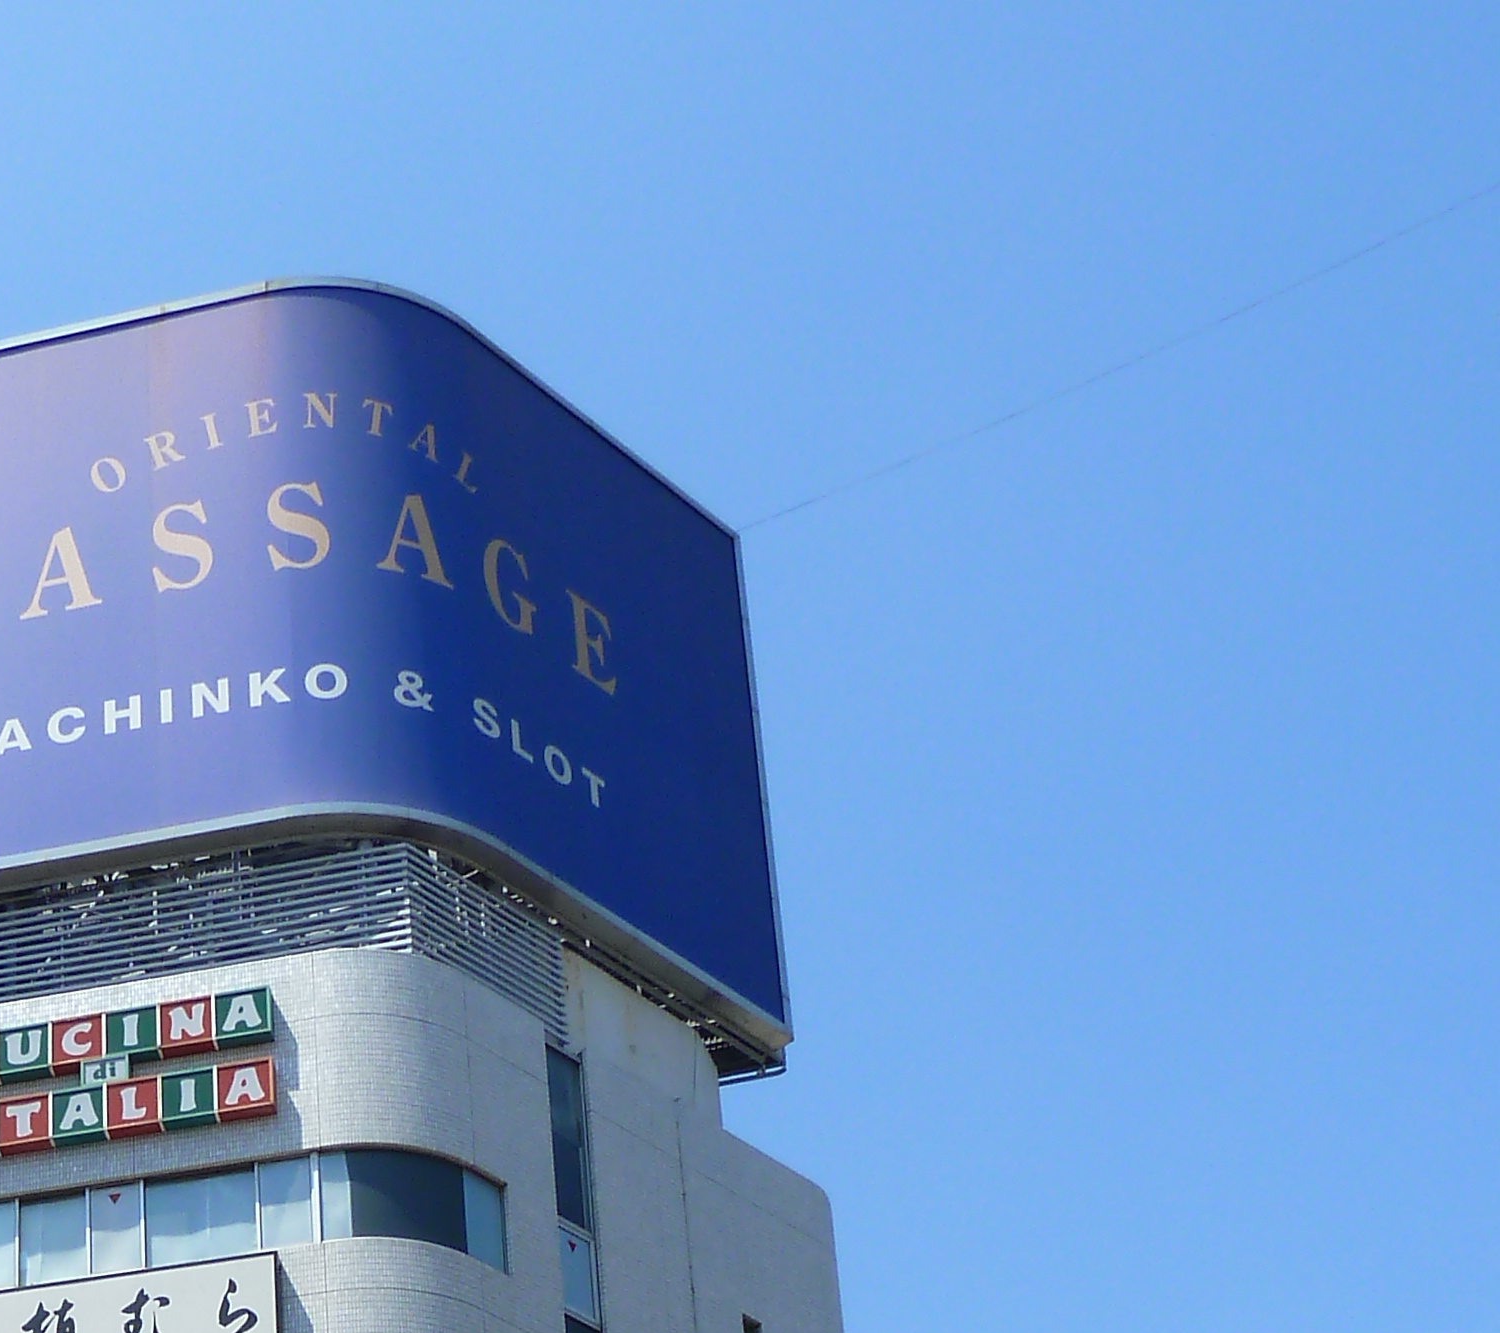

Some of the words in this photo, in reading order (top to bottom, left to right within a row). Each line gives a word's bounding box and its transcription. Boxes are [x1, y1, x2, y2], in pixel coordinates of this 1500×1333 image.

[90, 391, 482, 495] ORIENTAL
[392, 669, 435, 712] &
[471, 696, 607, 810] SLOT
[92, 1060, 117, 1081] di
